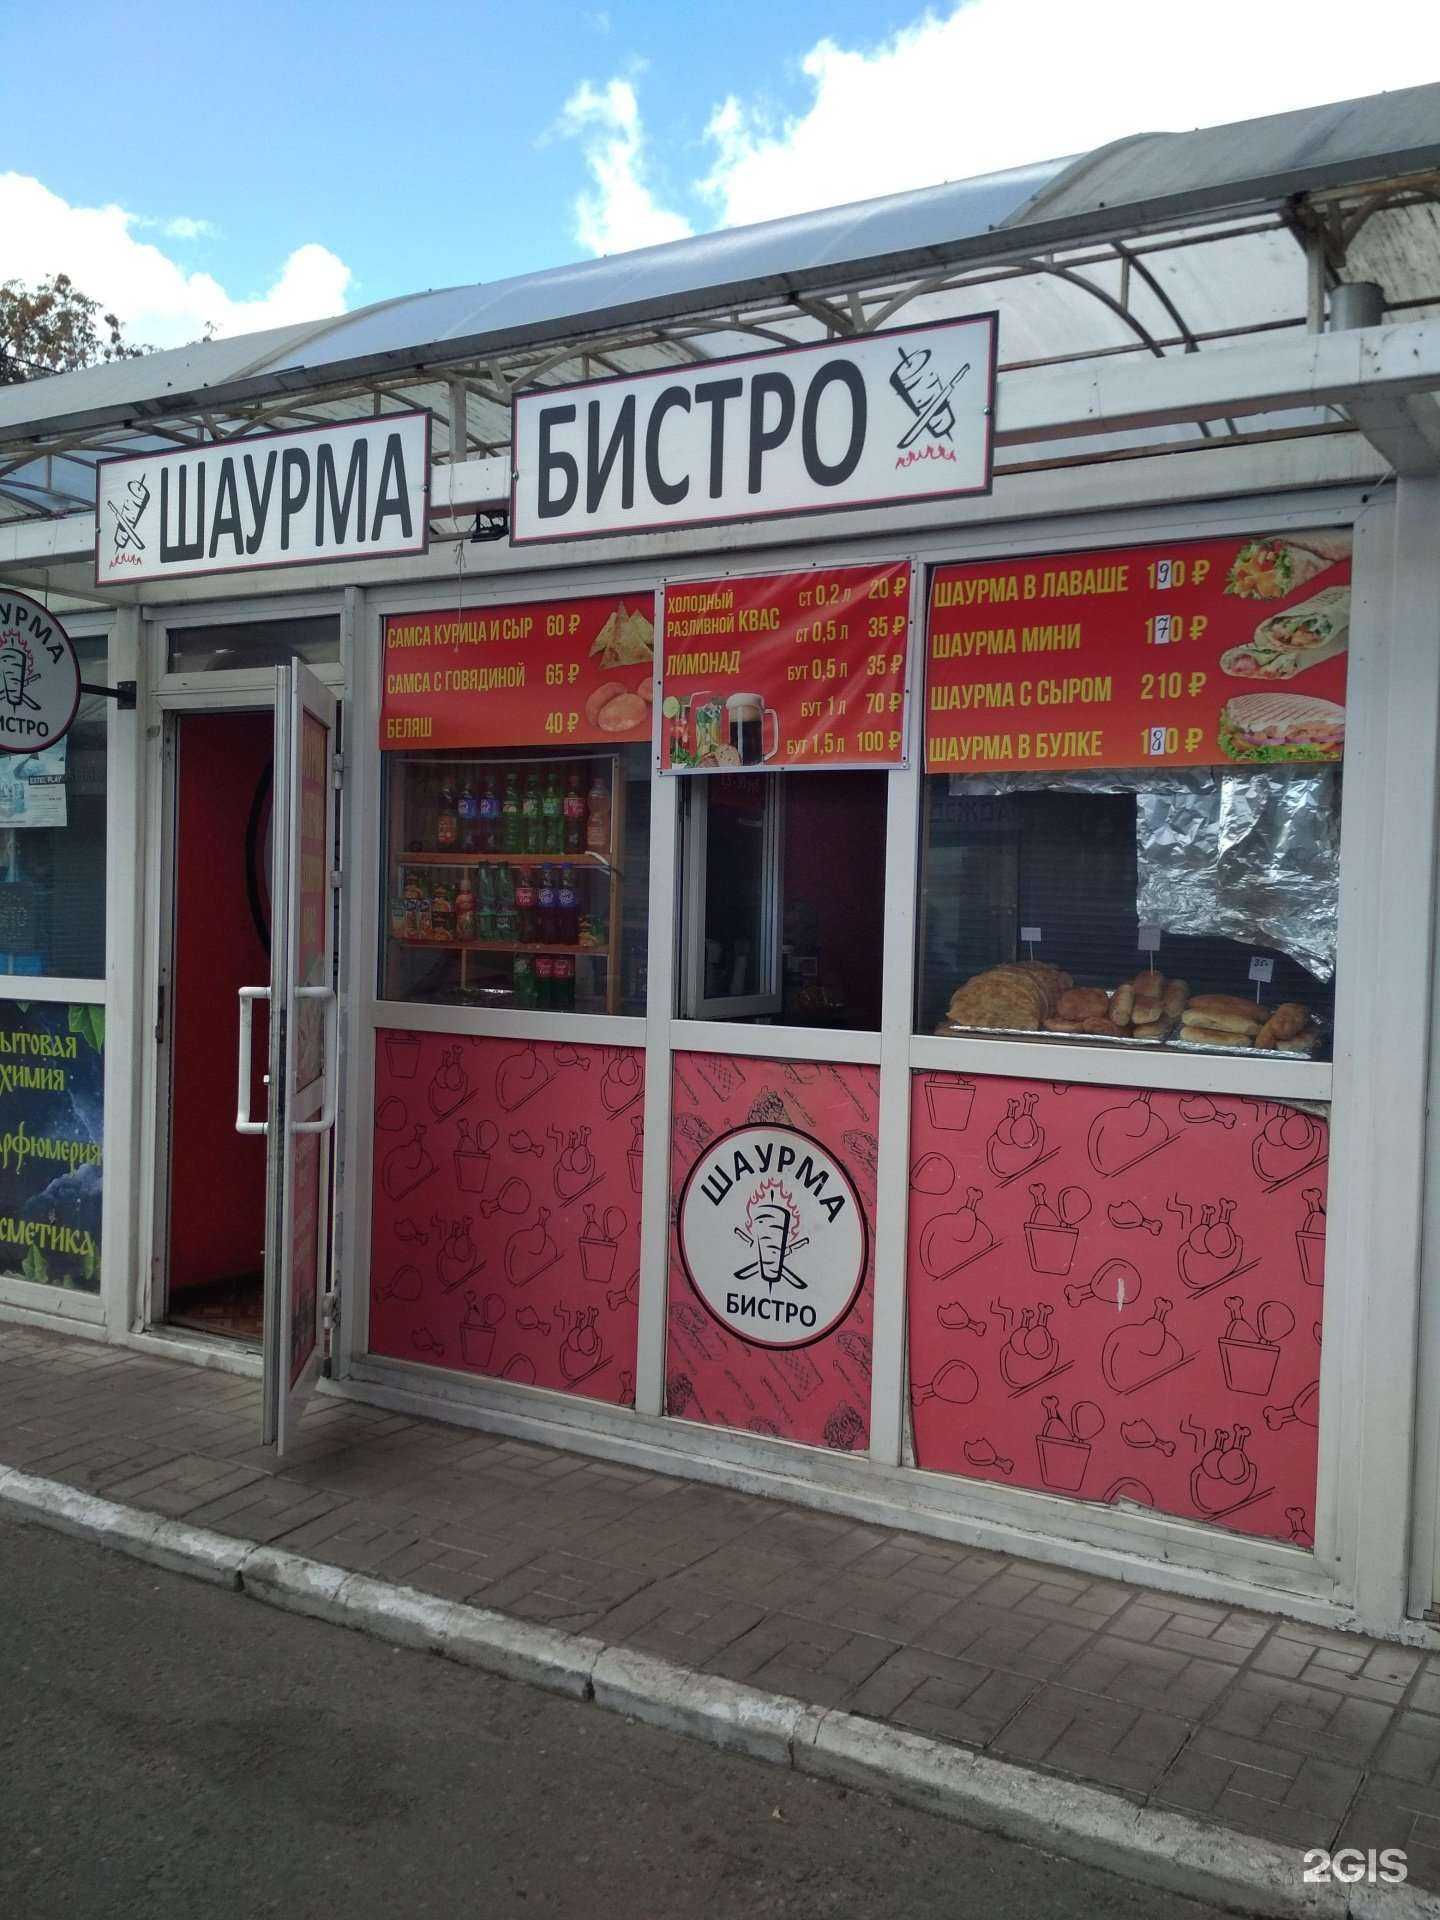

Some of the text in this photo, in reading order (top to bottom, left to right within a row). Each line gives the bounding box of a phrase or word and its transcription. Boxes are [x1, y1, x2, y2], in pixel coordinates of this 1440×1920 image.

[537, 359, 867, 519] БИСТРО
[159, 432, 413, 563] ШАУРМА
[868, 577, 889, 599] 20
[935, 574, 1018, 607] ШАУРМА
[1024, 572, 1036, 599] В
[1040, 564, 1129, 598] ЛАВАШЕ
[1147, 560, 1185, 589] 190
[668, 589, 733, 614] ХОЛОДНЫЙ
[387, 626, 430, 648] САМСА
[434, 621, 486, 645] КУРИЦА
[491, 620, 500, 640] И
[503, 616, 533, 640] СЫР
[546, 614, 565, 636] 60
[667, 608, 780, 637] РАЗЛИВНОЙ КВАС
[812, 620, 836, 643] 0,5
[868, 617, 888, 638] 35
[932, 625, 1017, 659] ШАУРМА
[1021, 623, 1081, 654] МИНИ
[1145, 615, 1183, 644] 170
[387, 673, 430, 695] САМСА
[445, 662, 526, 692] ГОВЯДИНОЙ
[546, 663, 564, 685] 65
[666, 651, 741, 676] ЛИМОНАД
[812, 658, 836, 682] 0,5
[867, 654, 886, 676] 35
[866, 692, 884, 714] 70
[931, 680, 1014, 711] ШАУРМА
[1037, 676, 1112, 705] СЫРОМ
[1142, 672, 1182, 700] 210
[387, 717, 432, 739] БЕЛЯШ
[545, 712, 563, 734] 40
[813, 733, 834, 756] 1,5
[857, 731, 883, 753] 100
[929, 732, 1011, 762] ШАУРМА
[1018, 732, 1030, 759] В
[1036, 730, 1103, 758] БУЛКЕ
[1141, 727, 1178, 755] 180
[701, 1143, 846, 1223] ШАУРМА
[726, 1292, 817, 1327] БИСТРО
